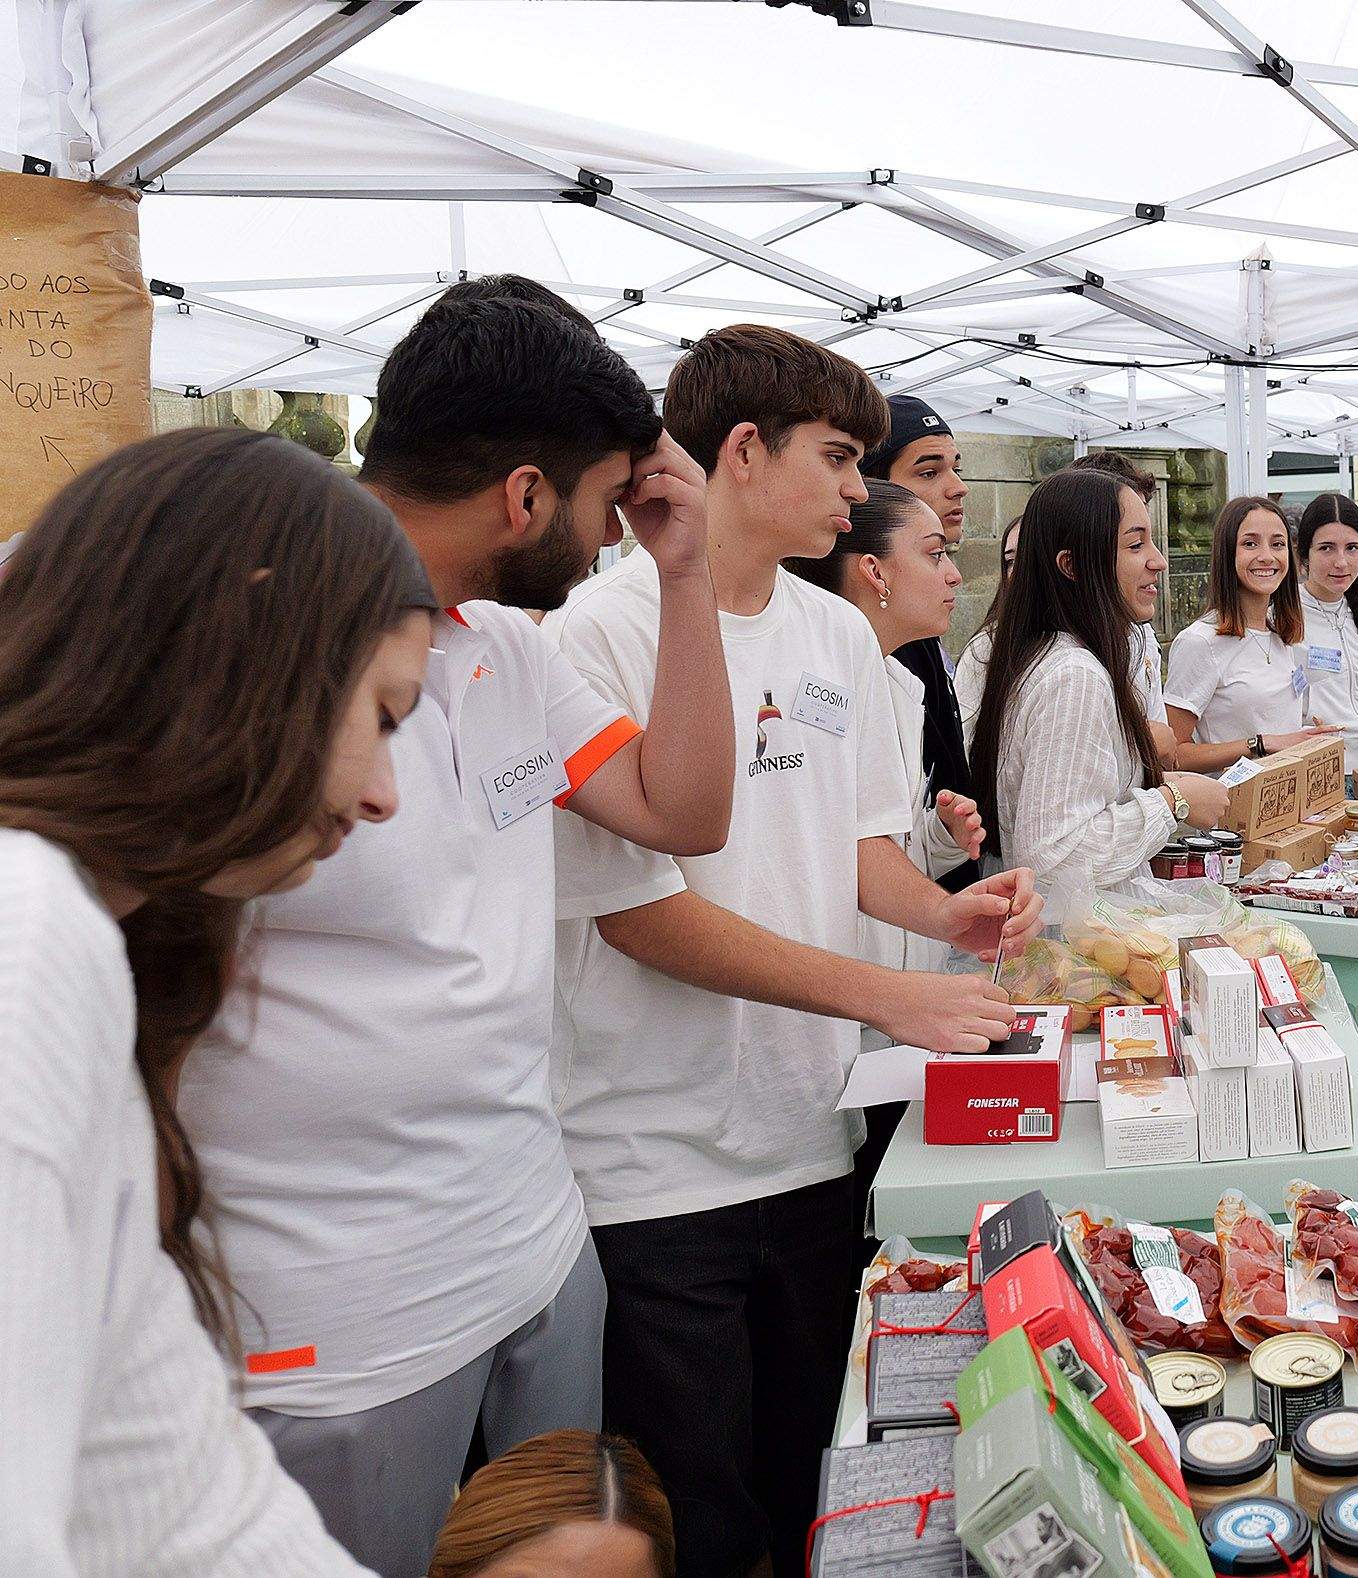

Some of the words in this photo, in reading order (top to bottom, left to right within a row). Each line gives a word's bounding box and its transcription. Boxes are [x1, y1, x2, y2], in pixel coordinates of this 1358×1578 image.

[40, 274, 90, 294] AOS
[0, 309, 70, 330] NTA
[28, 339, 73, 359] DO
[805, 682, 849, 711] ECOSIM
[493, 750, 554, 794] ECOSIM
[967, 1097, 1020, 1109] FONESTAR
